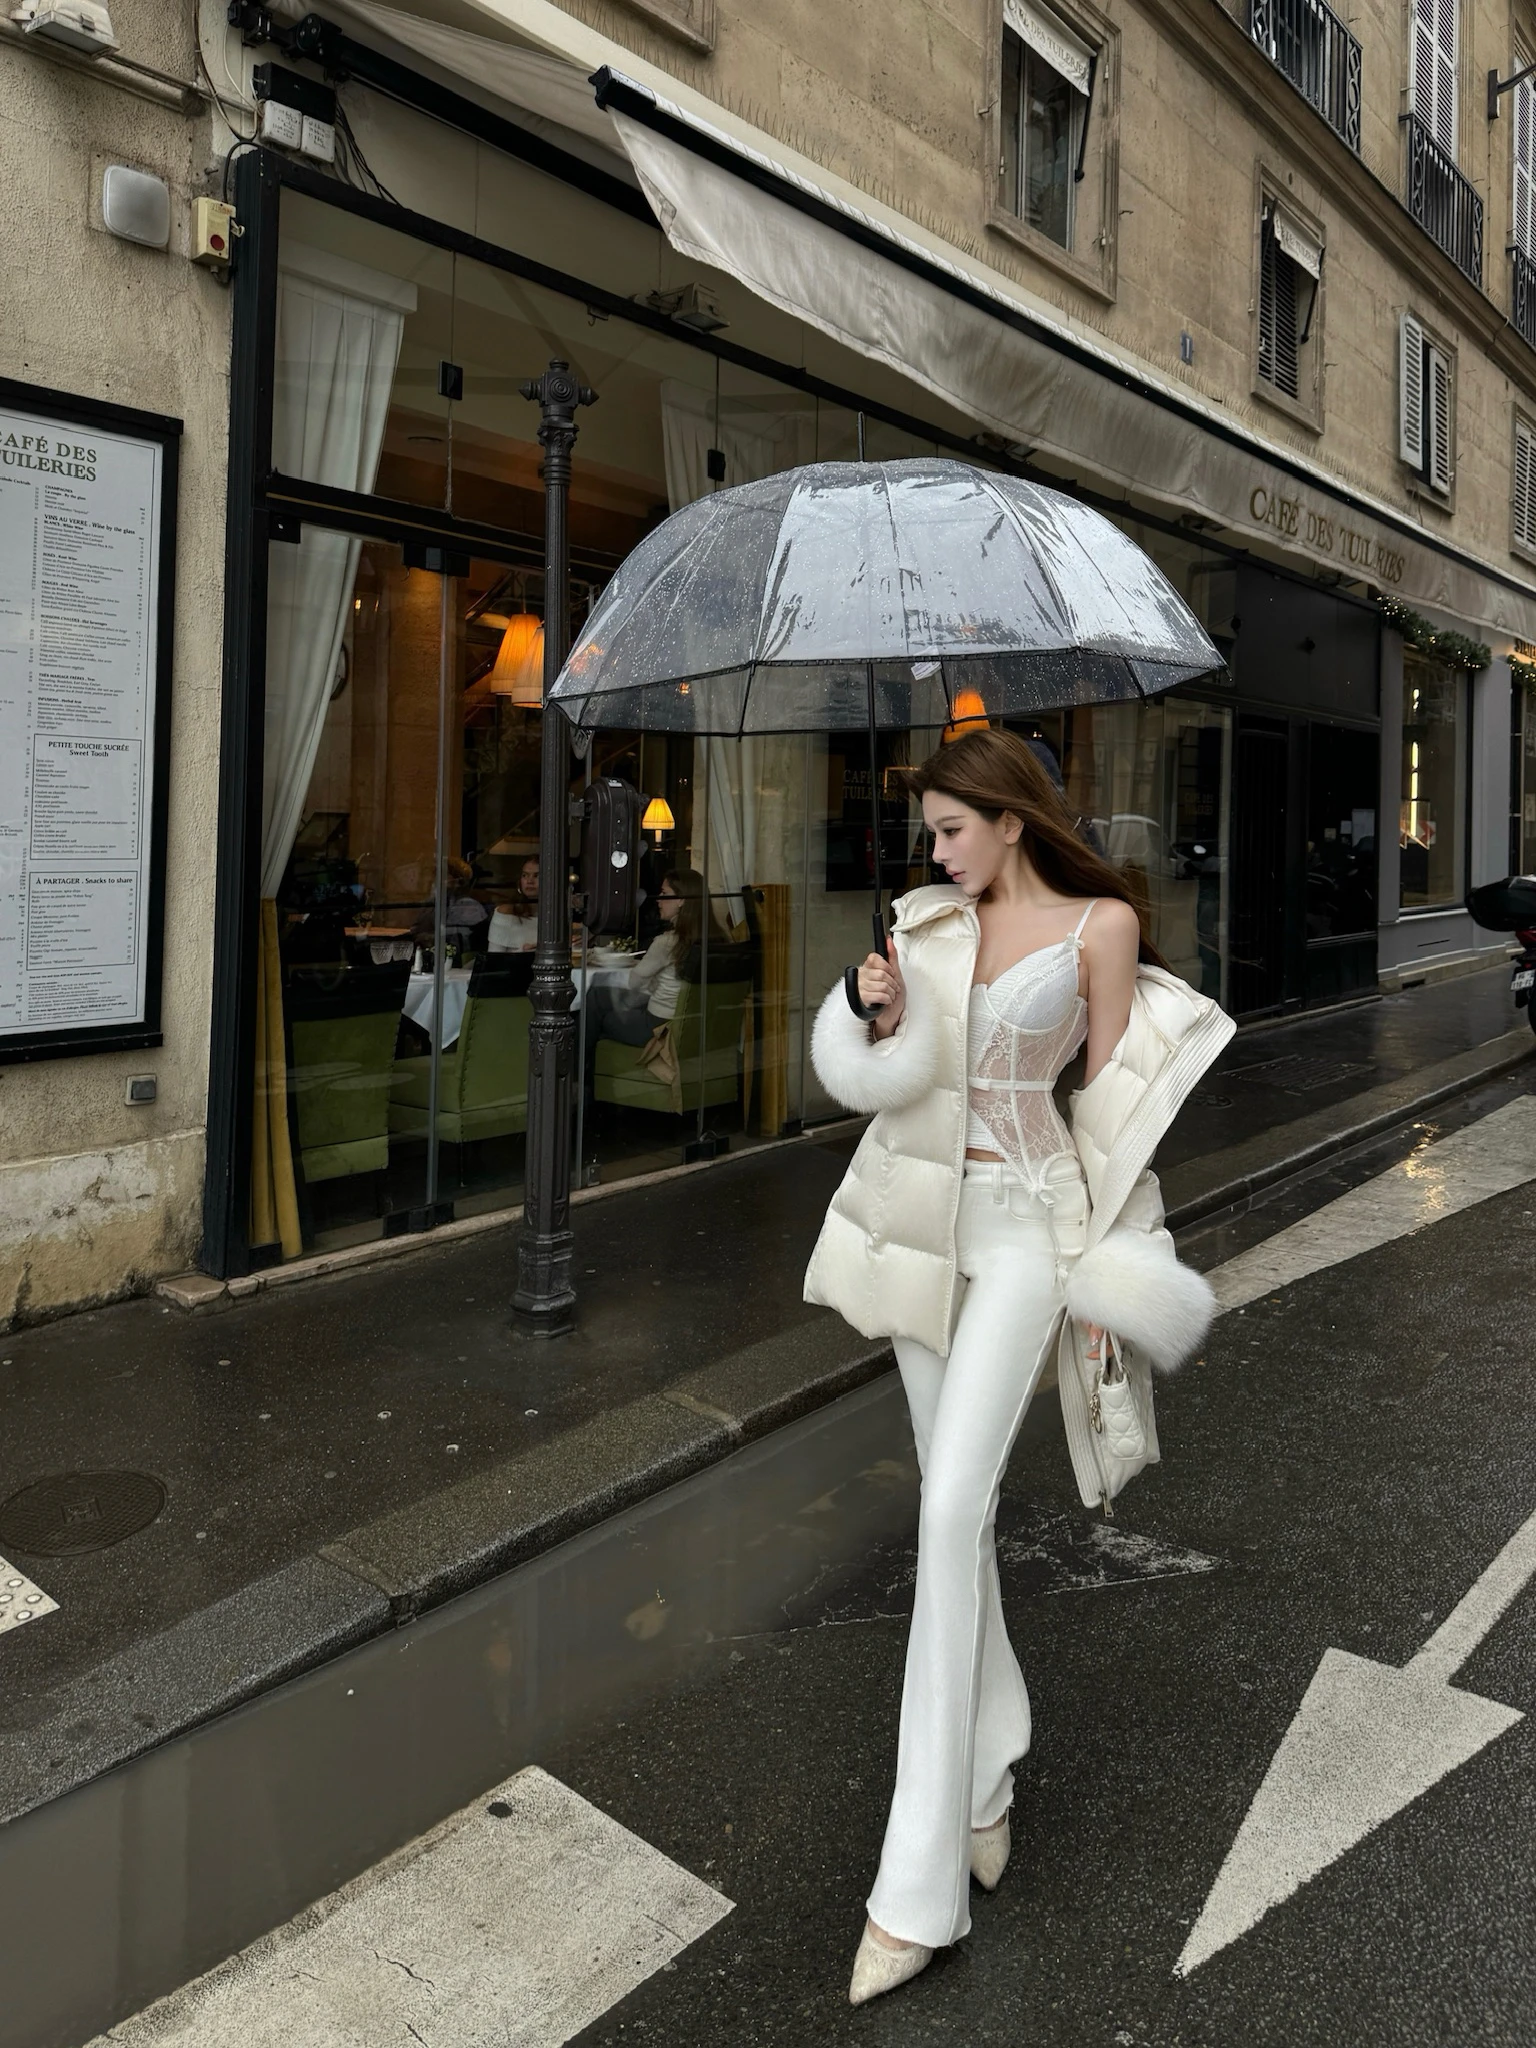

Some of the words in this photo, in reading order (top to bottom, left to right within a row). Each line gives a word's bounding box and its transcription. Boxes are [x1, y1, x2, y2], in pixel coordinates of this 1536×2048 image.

[0, 432, 49, 454] AFÉ
[56, 442, 97, 463] DES
[0, 449, 97, 482] UILERIES
[69, 518, 87, 527] VERRE
[105, 523, 113, 532] by
[123, 527, 135, 535] glass
[1250, 488, 1300, 536] CAFÉ
[1306, 511, 1334, 552] DES
[1339, 527, 1405, 583] TUILRIES
[48, 741, 73, 749] PETITE
[74, 742, 103, 750] TOUCHE
[104, 743, 130, 752] SUCRÉE
